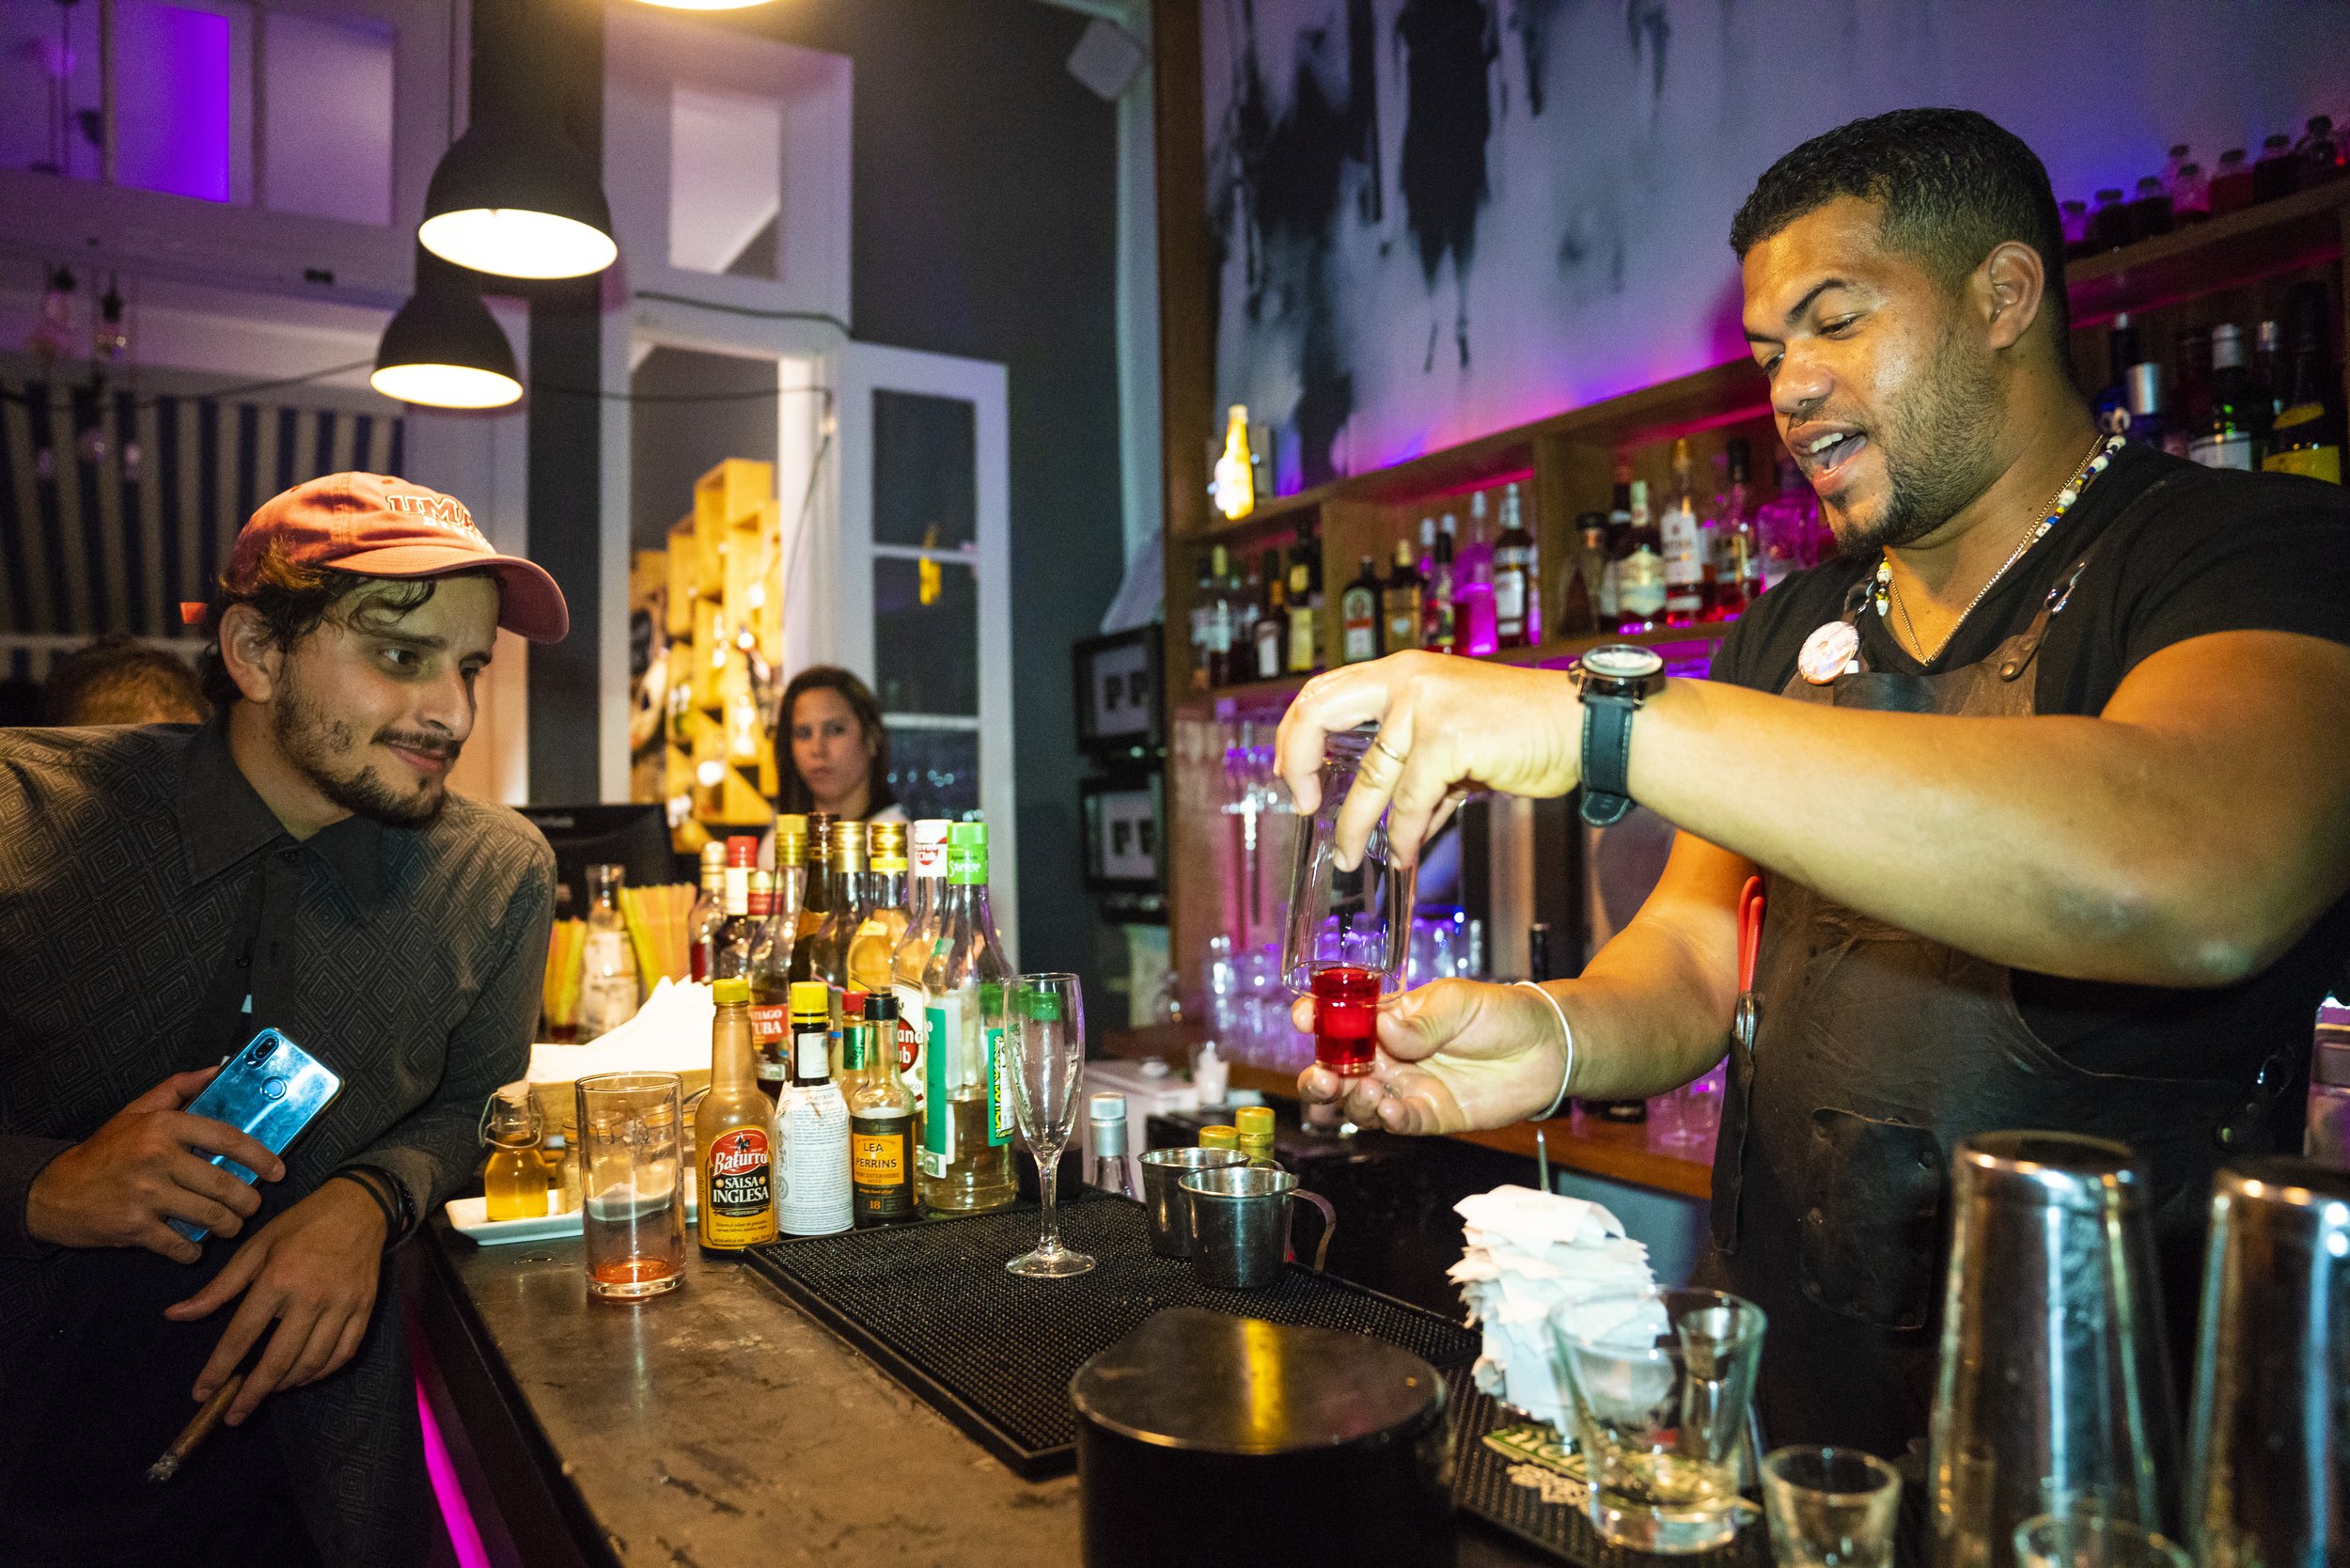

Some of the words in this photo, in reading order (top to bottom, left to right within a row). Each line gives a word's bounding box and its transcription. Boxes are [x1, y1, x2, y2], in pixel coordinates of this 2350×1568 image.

[863, 1142, 884, 1152] LEA
[713, 1151, 768, 1177] Baturro
[855, 1156, 898, 1169] PERRINS
[725, 1176, 759, 1189] SALSA
[713, 1186, 769, 1203] INGLESA
[869, 1200, 881, 1210] 18
